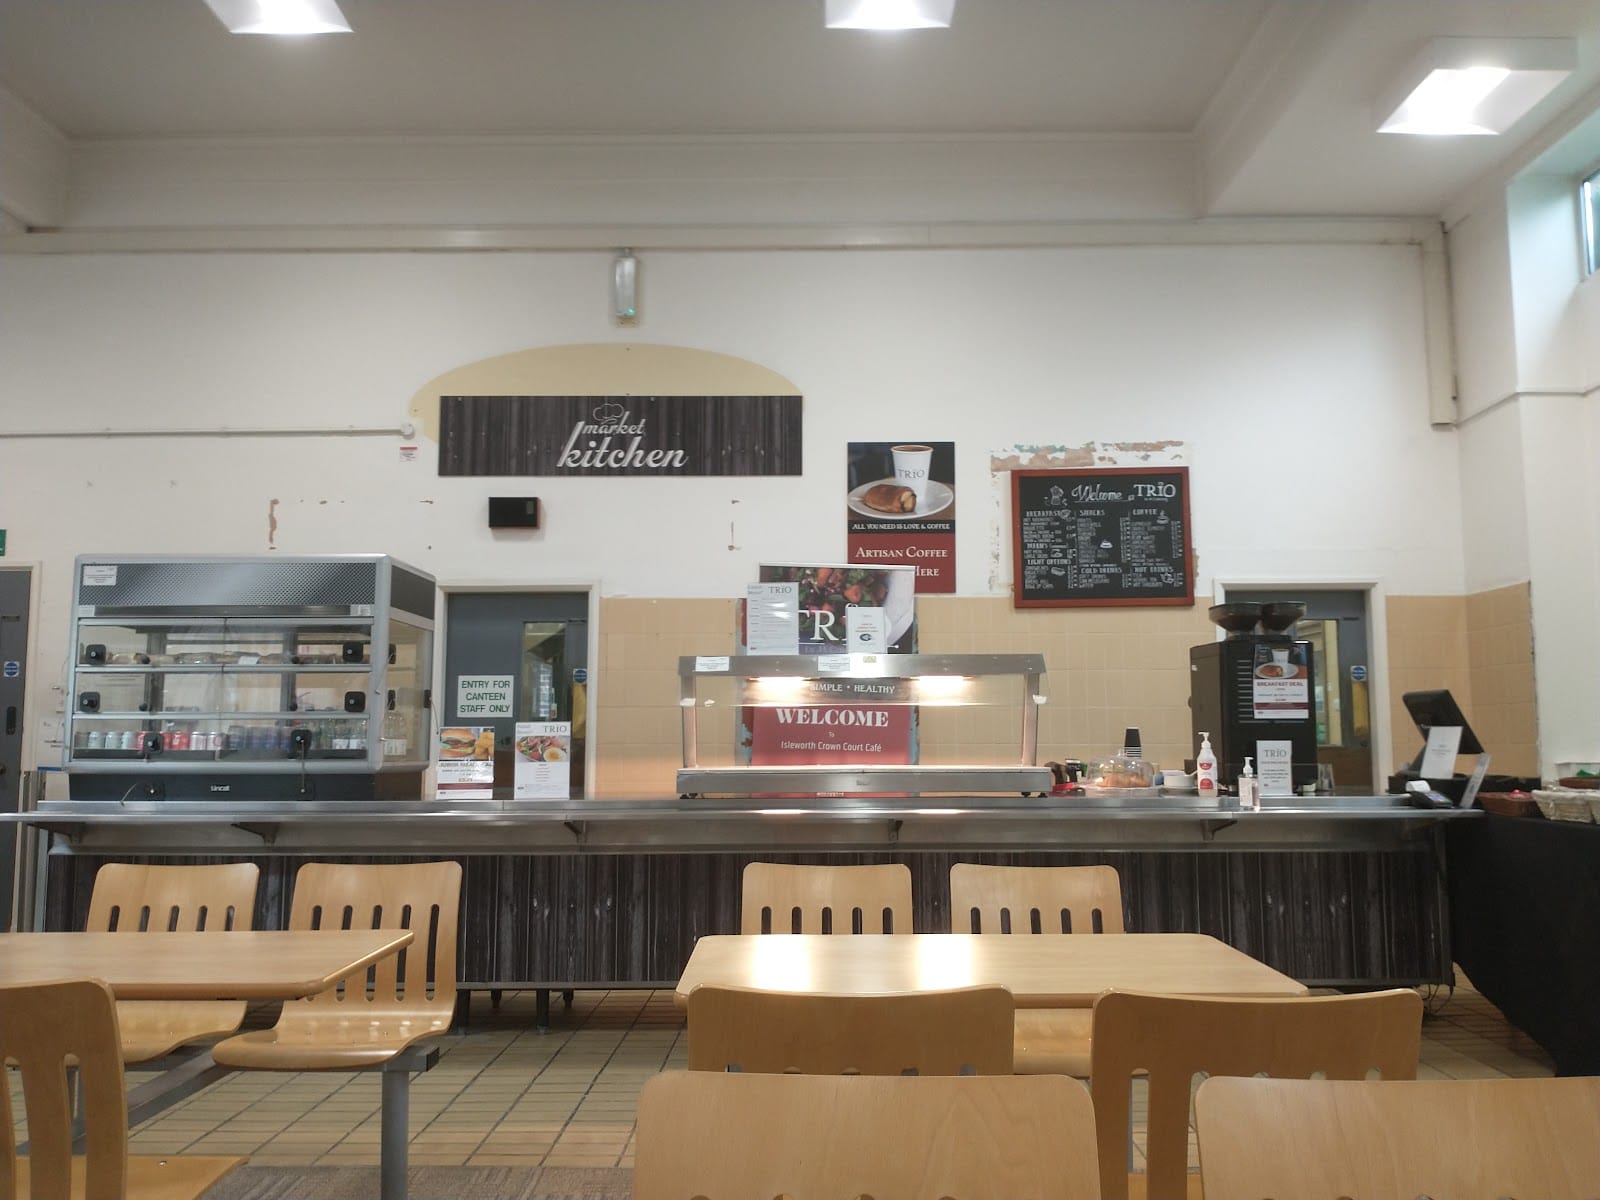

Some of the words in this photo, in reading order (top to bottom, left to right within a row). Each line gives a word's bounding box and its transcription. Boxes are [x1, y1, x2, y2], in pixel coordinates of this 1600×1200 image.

[581, 411, 646, 435] market
[556, 421, 689, 468] kitchen
[1071, 483, 1122, 502] Welcome
[461, 681, 489, 689] ENTRY
[493, 681, 510, 689] FOR
[854, 684, 895, 694] HEALTHY
[465, 692, 506, 701] CANTEEN
[460, 704, 486, 713] STAFF
[489, 704, 511, 713] ONLY
[776, 708, 889, 728] WELCOME
[781, 741, 816, 750] Isleworth
[817, 741, 842, 750] Crown
[842, 742, 864, 752] Court
[865, 742, 882, 753] Café
